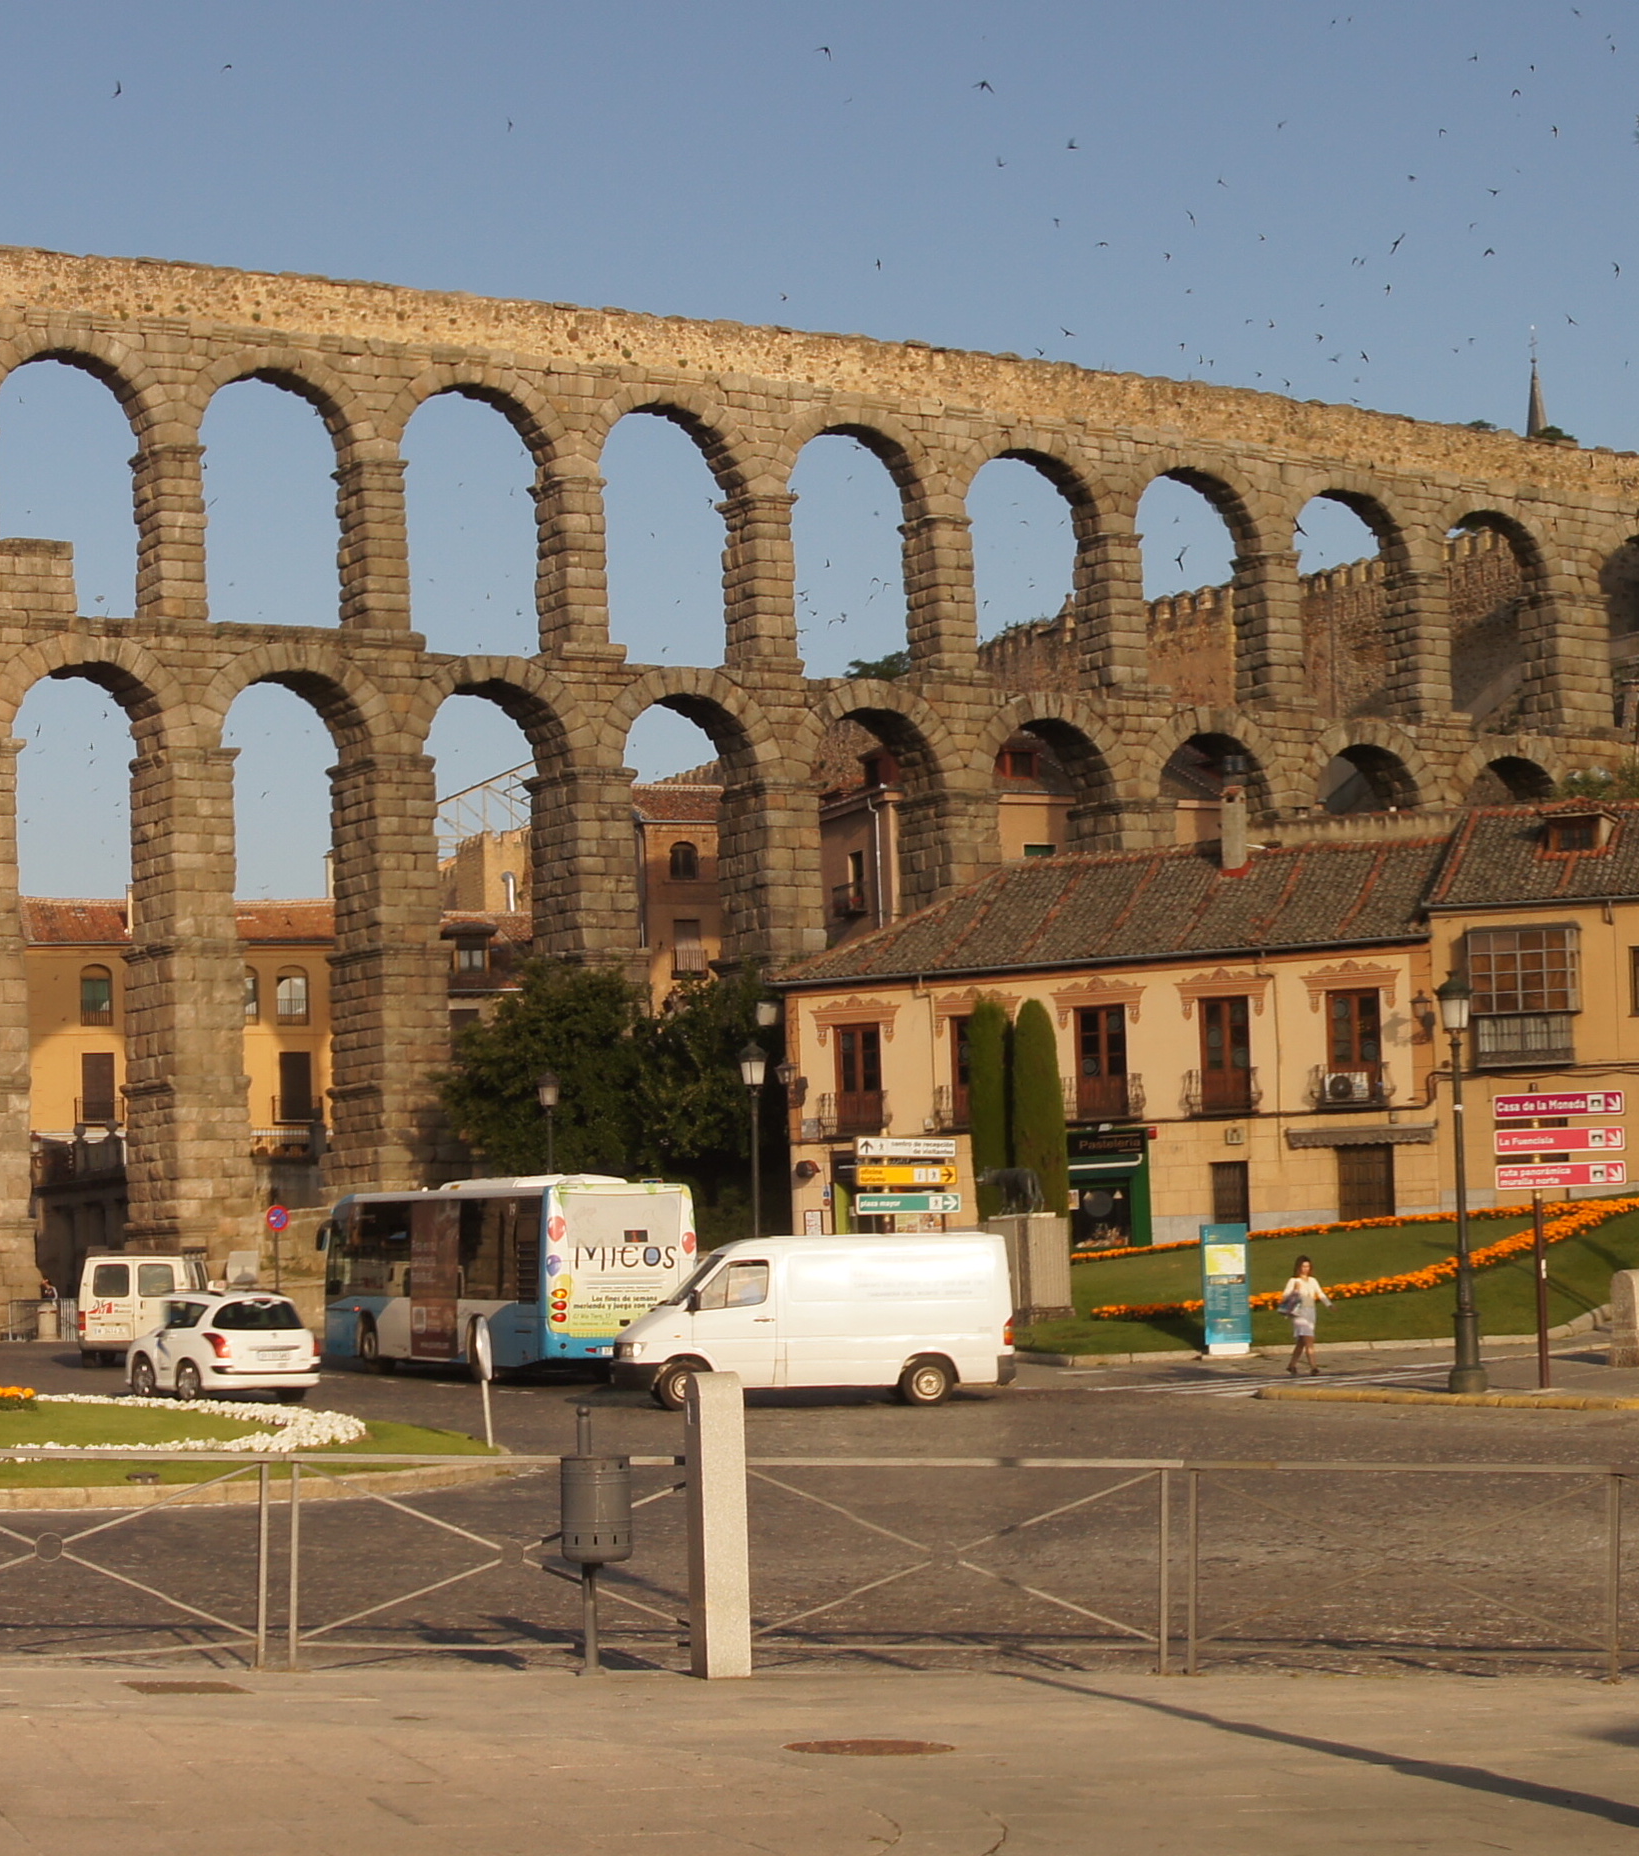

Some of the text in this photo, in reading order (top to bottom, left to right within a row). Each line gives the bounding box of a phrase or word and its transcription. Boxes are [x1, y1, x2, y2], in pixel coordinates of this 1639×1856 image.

[1496, 1099, 1586, 1112] Casa de la Moneda
[1499, 1136, 1555, 1146] La Fuencisla
[1520, 1167, 1572, 1177] panorámica
[1500, 1178, 1560, 1187] muralla norte
[860, 1200, 902, 1209] plaza mayor
[613, 1303, 632, 1311] juega
